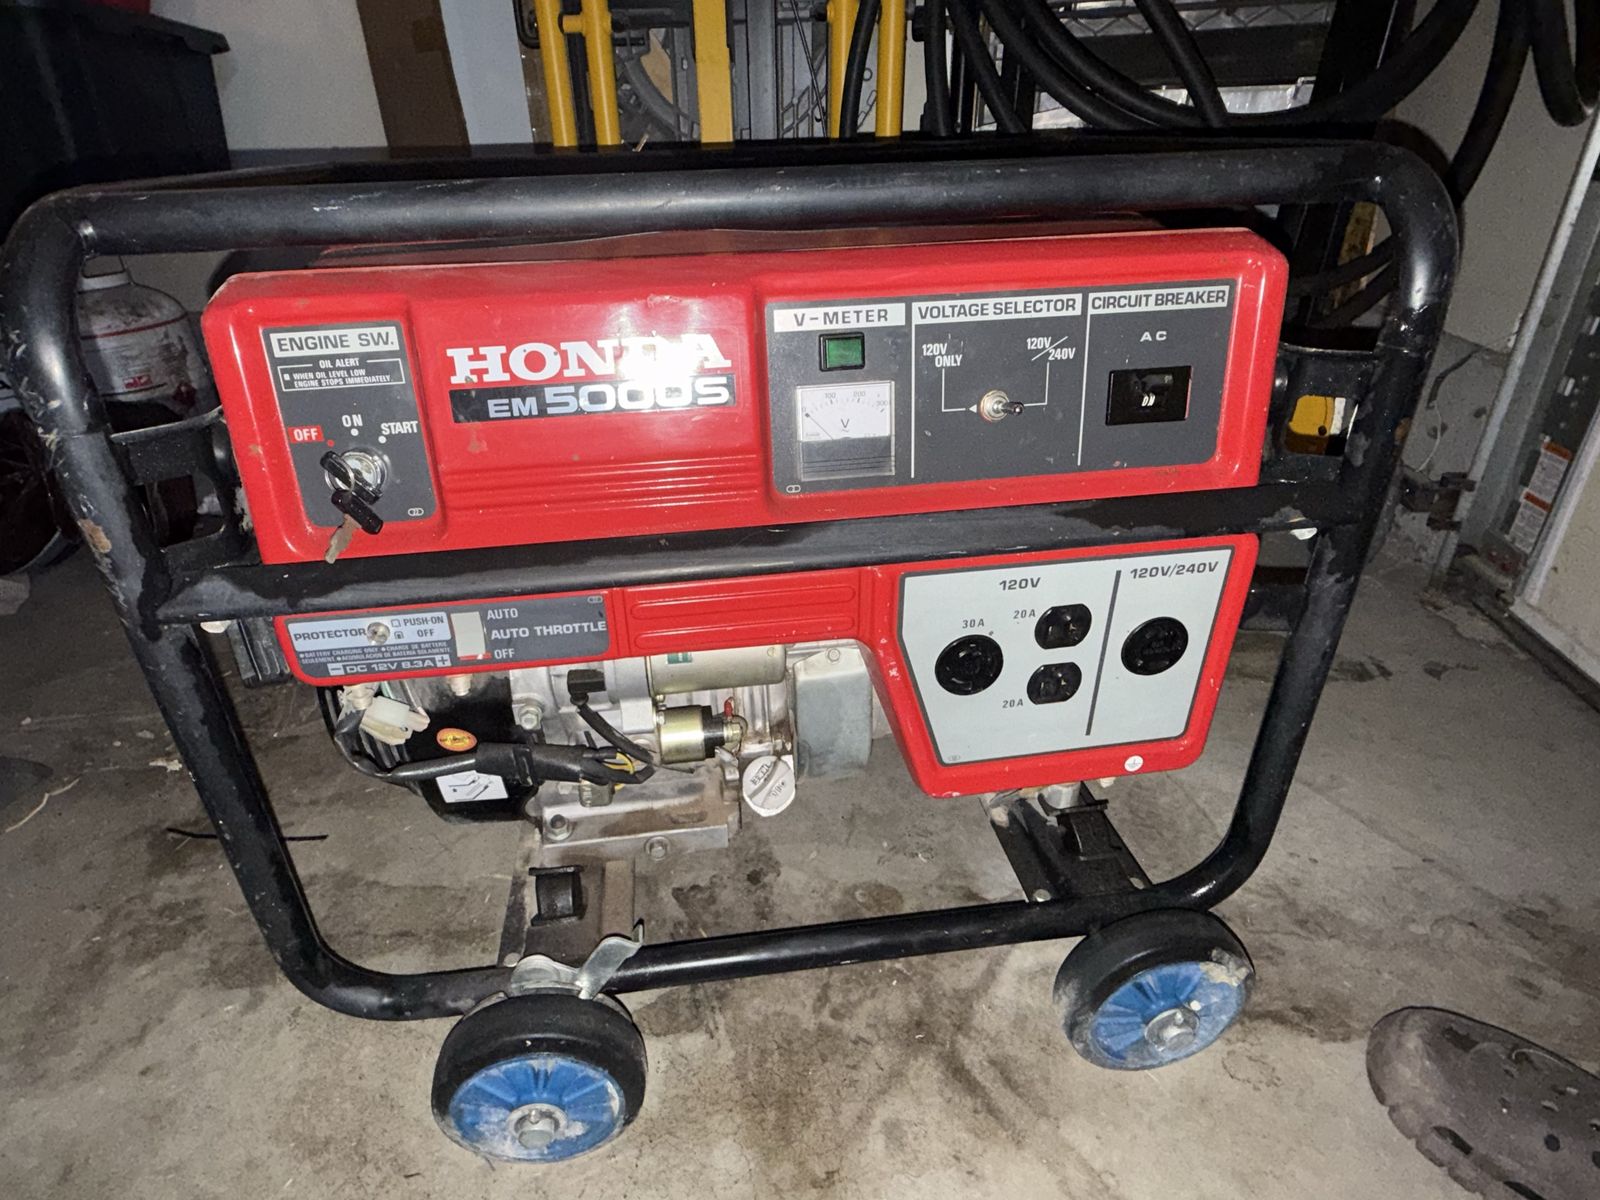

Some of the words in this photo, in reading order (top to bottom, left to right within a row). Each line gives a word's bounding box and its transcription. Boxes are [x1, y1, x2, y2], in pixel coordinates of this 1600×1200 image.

[1092, 294, 1152, 310] CIRCUIT
[1154, 290, 1226, 306] BREAKER
[918, 303, 989, 319] VOLTAGE
[993, 298, 1076, 315] SELECTOR
[277, 334, 350, 352] ENGINE
[358, 332, 394, 346] SW.
[922, 343, 947, 356] 120V
[319, 360, 333, 368] OIL
[336, 358, 360, 367] ALERT
[934, 354, 962, 367] ONLY
[293, 372, 314, 380] WHEN
[316, 371, 326, 379] OIL
[350, 368, 366, 376] LOW
[294, 380, 319, 388] ENGINE
[321, 378, 343, 386] STOPS
[487, 396, 538, 418] EM
[544, 376, 730, 415] 5000S
[342, 414, 363, 427] ON
[294, 428, 318, 441] OFF
[381, 421, 418, 436] START
[1130, 561, 1219, 579] 120V/240V
[1000, 577, 1041, 591] 120V
[487, 608, 518, 620] AUTO
[403, 616, 443, 626] PUSH-ON
[294, 628, 366, 641] PROTECTOR
[417, 628, 435, 637] OFF
[491, 627, 529, 640] AUTO
[534, 621, 607, 637] THROTTLE
[494, 648, 514, 659] OFF
[346, 664, 367, 673] DC
[371, 660, 398, 672] 12V
[402, 659, 435, 669] 8.3A
